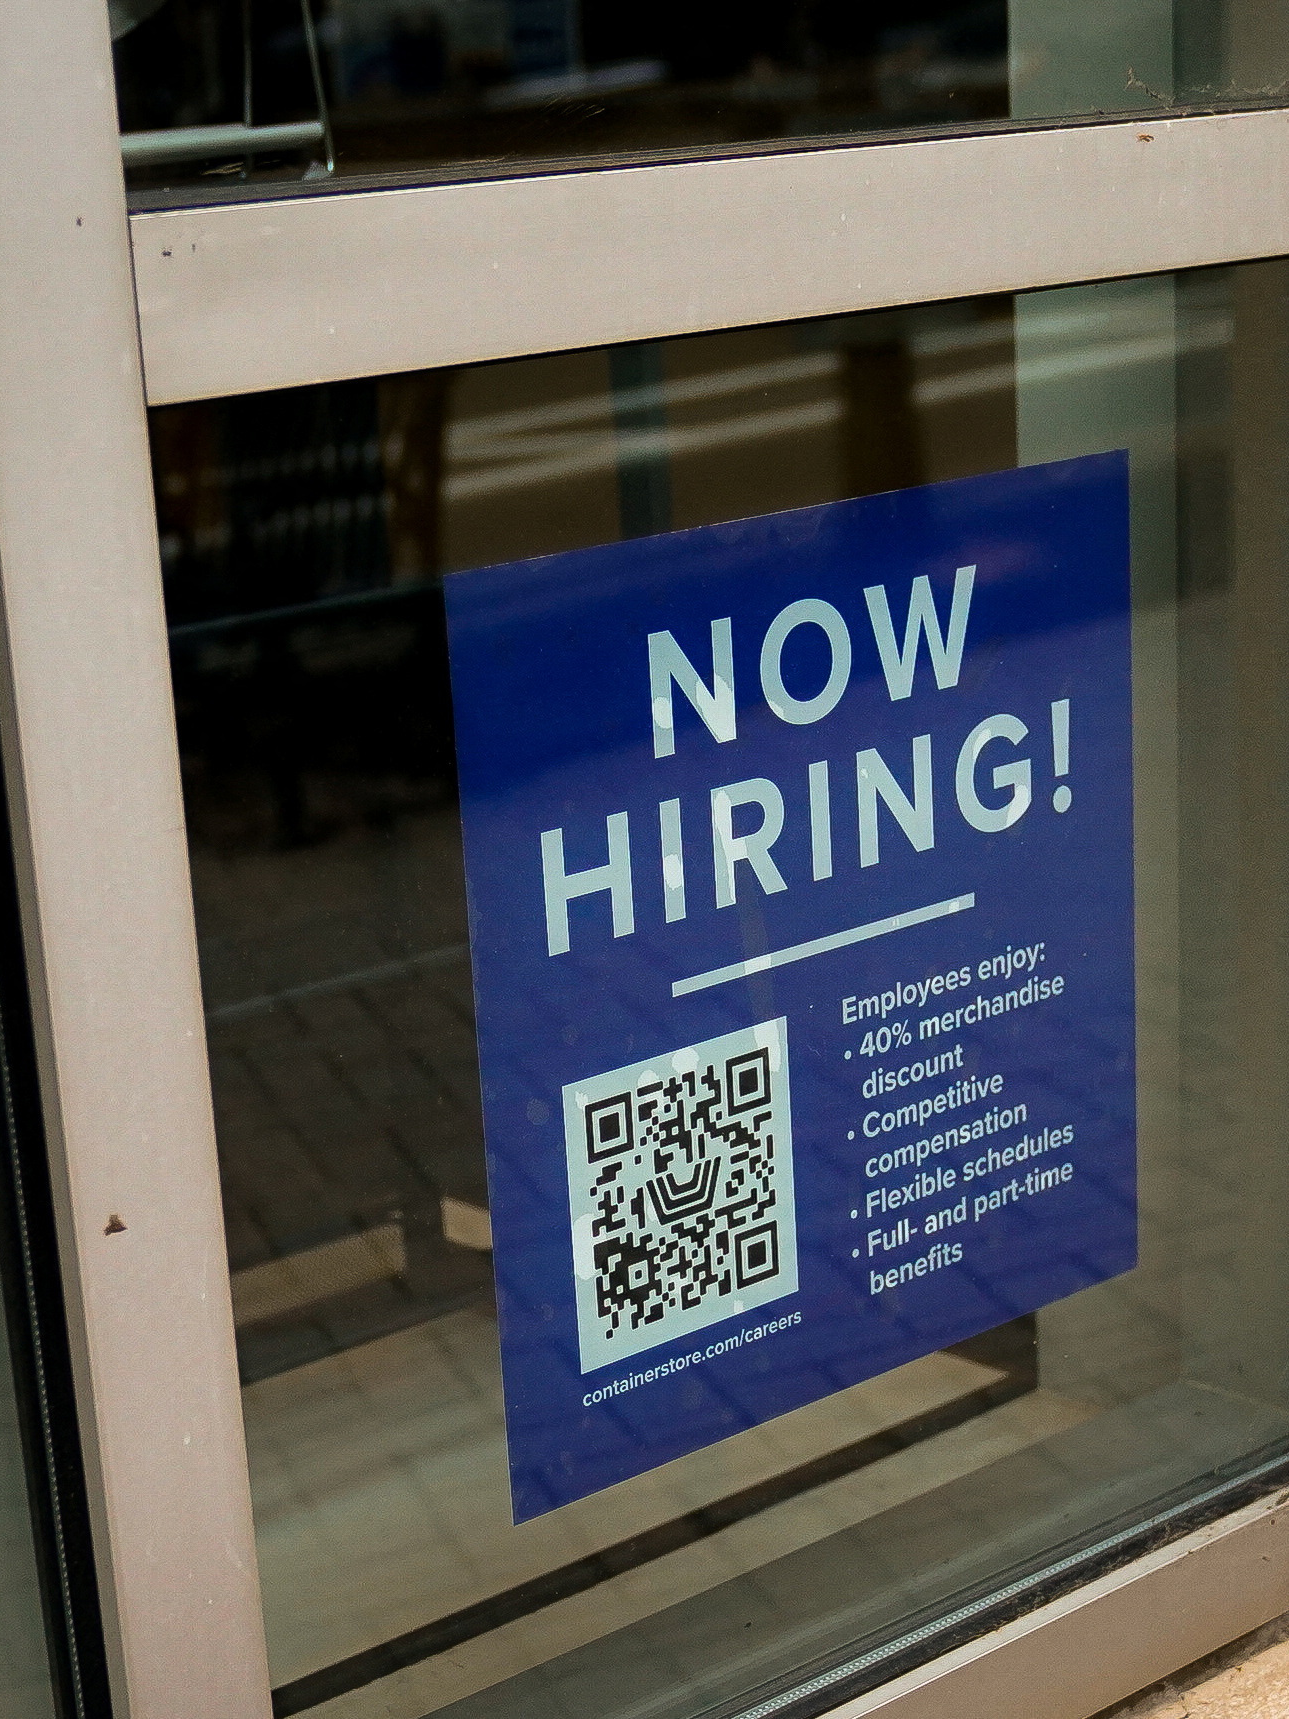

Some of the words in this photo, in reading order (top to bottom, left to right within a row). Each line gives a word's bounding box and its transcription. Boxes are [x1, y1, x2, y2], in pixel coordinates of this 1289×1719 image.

[647, 564, 977, 759] NOW
[540, 698, 1072, 957] HIRING!
[842, 965, 972, 1025] Employees
[977, 942, 1046, 979] enjoy:
[859, 1019, 912, 1058] 40%
[919, 975, 1065, 1040] merchandise
[862, 1044, 964, 1099] discount
[862, 1073, 1004, 1138] Competitive
[865, 1103, 1028, 1178] compensation
[866, 1167, 957, 1218] Flexible
[963, 1124, 1075, 1182] schedules
[867, 1218, 918, 1257] Full-
[924, 1196, 967, 1235] and
[974, 1162, 1074, 1222] part-time
[870, 1242, 963, 1295] benefits
[582, 1310, 802, 1407] containerstore.com/careers
